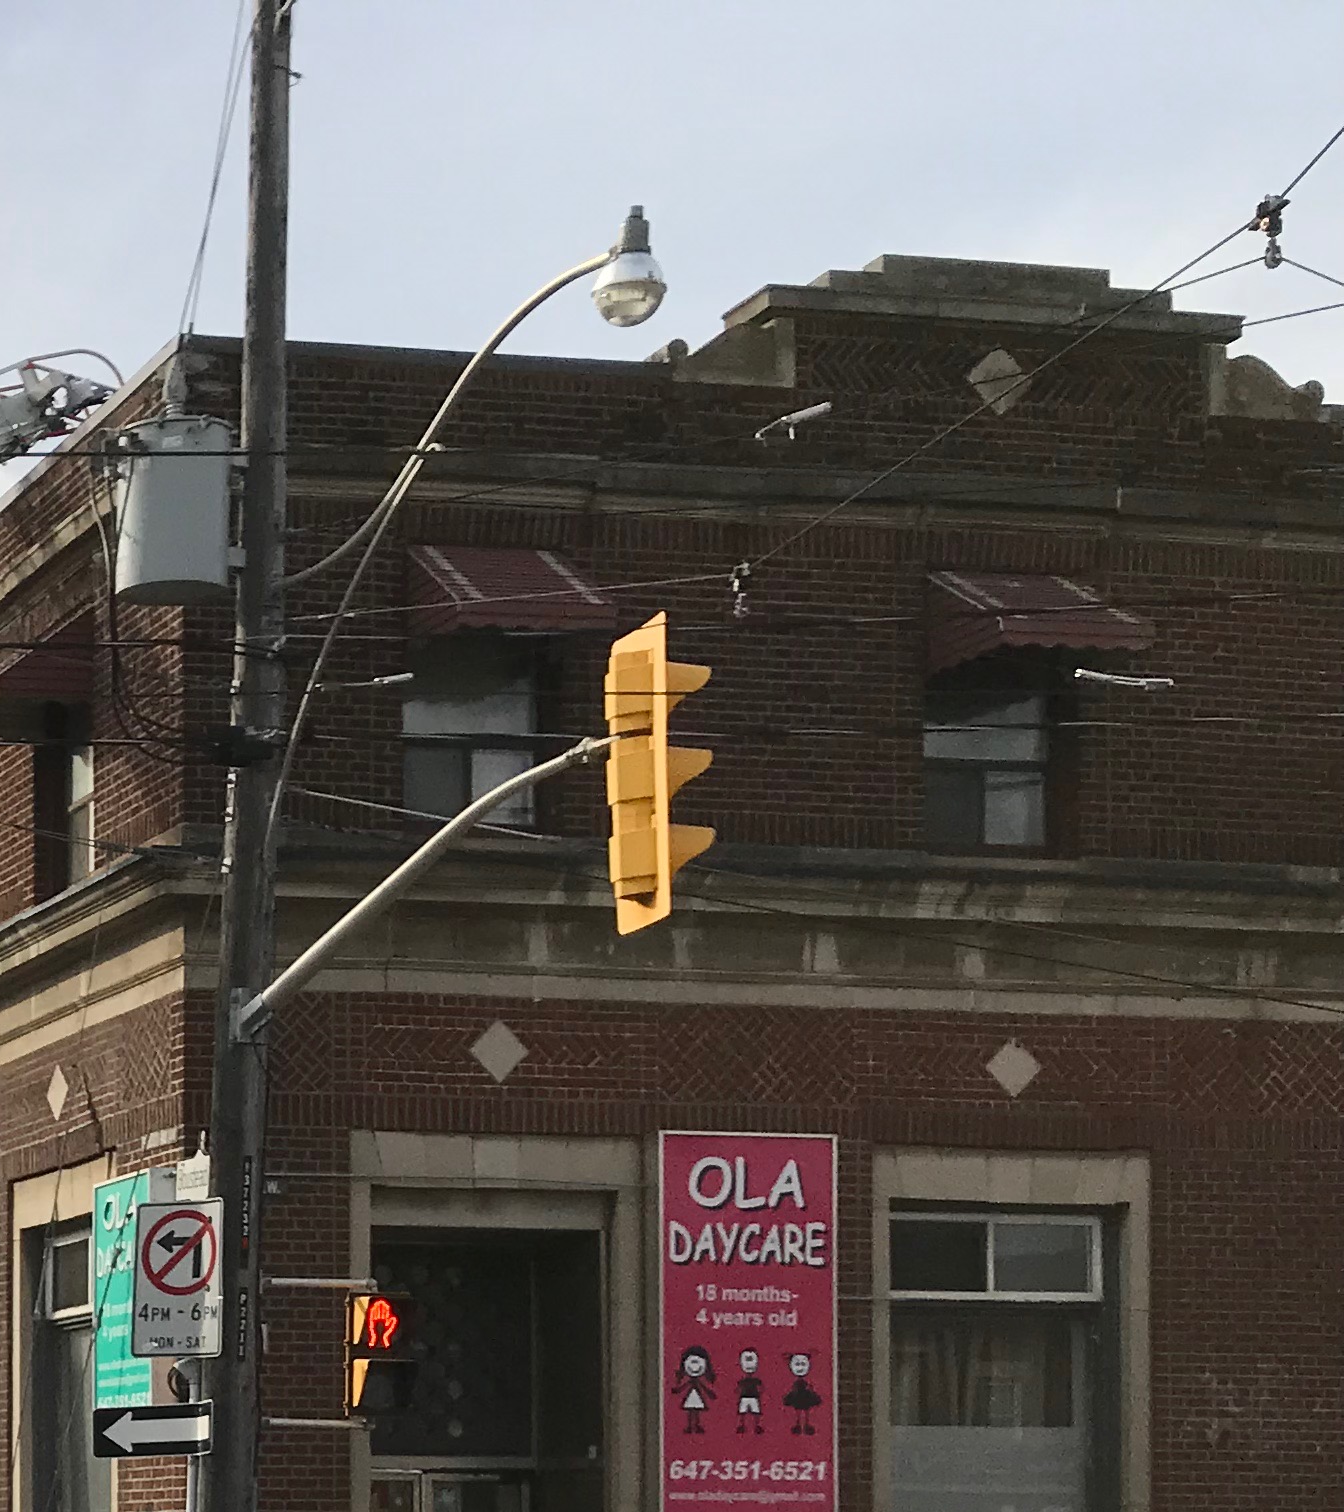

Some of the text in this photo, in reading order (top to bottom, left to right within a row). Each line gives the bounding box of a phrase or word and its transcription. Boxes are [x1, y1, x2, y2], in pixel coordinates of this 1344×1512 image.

[688, 1156, 806, 1209] OLA
[668, 1220, 827, 1266] DAYCARE
[138, 1302, 171, 1322] 4PM
[190, 1302, 218, 1321] 6PM
[695, 1307, 798, 1329] 4 years old
[185, 1335, 207, 1349] SAT
[669, 1459, 828, 1481] 647-351-6521
